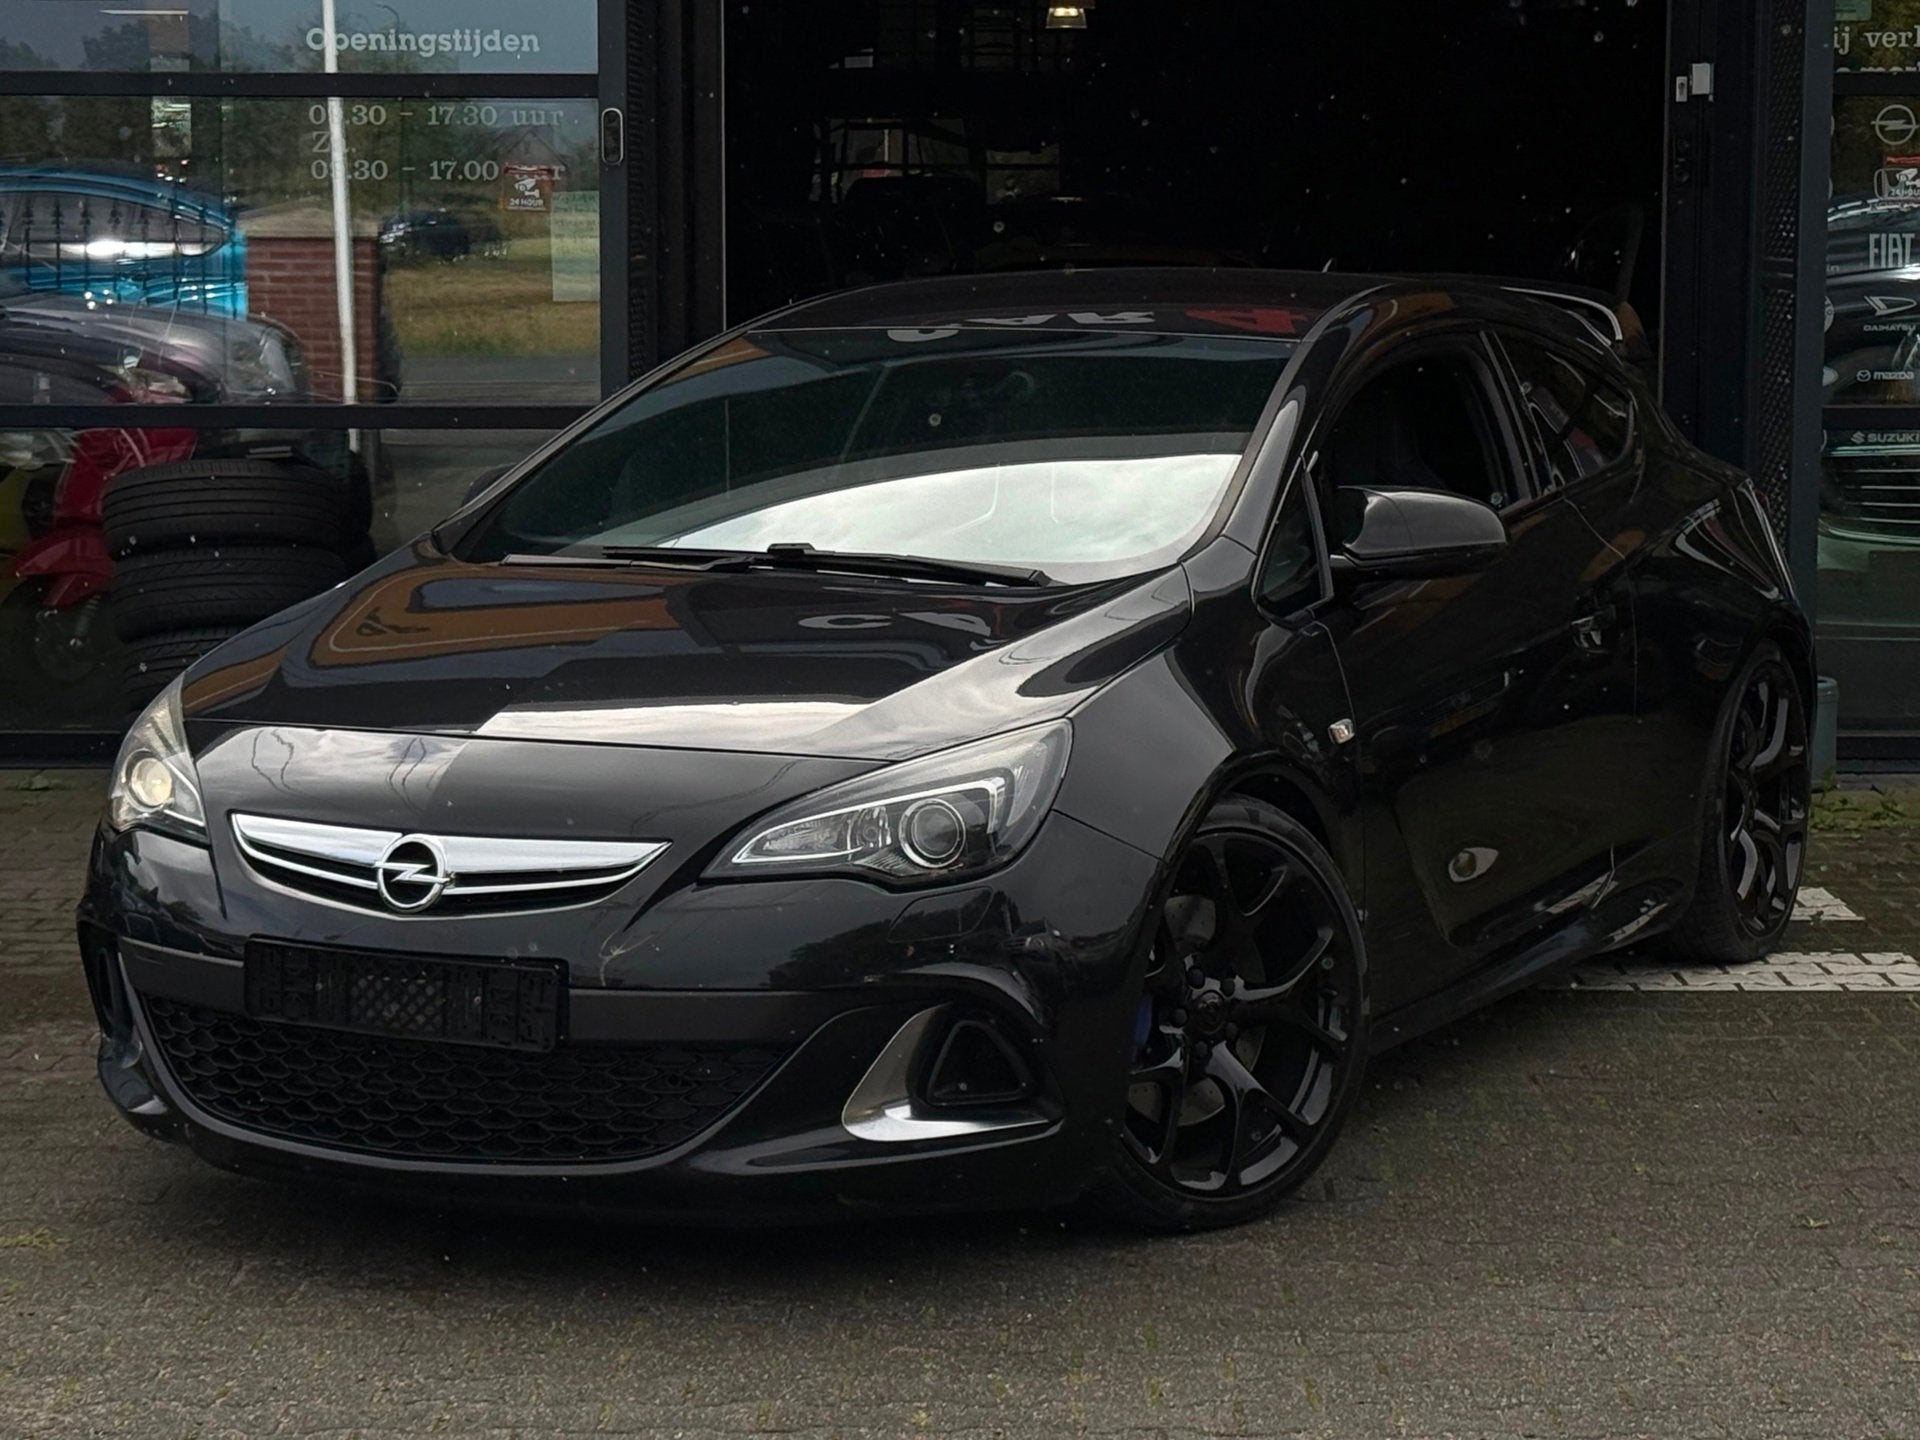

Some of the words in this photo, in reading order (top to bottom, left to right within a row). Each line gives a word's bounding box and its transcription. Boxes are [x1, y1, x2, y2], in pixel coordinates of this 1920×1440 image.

[306, 28, 540, 57] Openingstijden
[309, 104, 387, 126] 0.30
[428, 105, 498, 126] 17.30
[512, 109, 563, 126] uur
[312, 131, 356, 153] Z.
[311, 160, 388, 181] 0.30
[429, 160, 499, 181] 17.00
[1869, 233, 1915, 268] FIAT
[1873, 371, 1914, 380] mazda
[1867, 433, 1920, 443] SUZUKI
